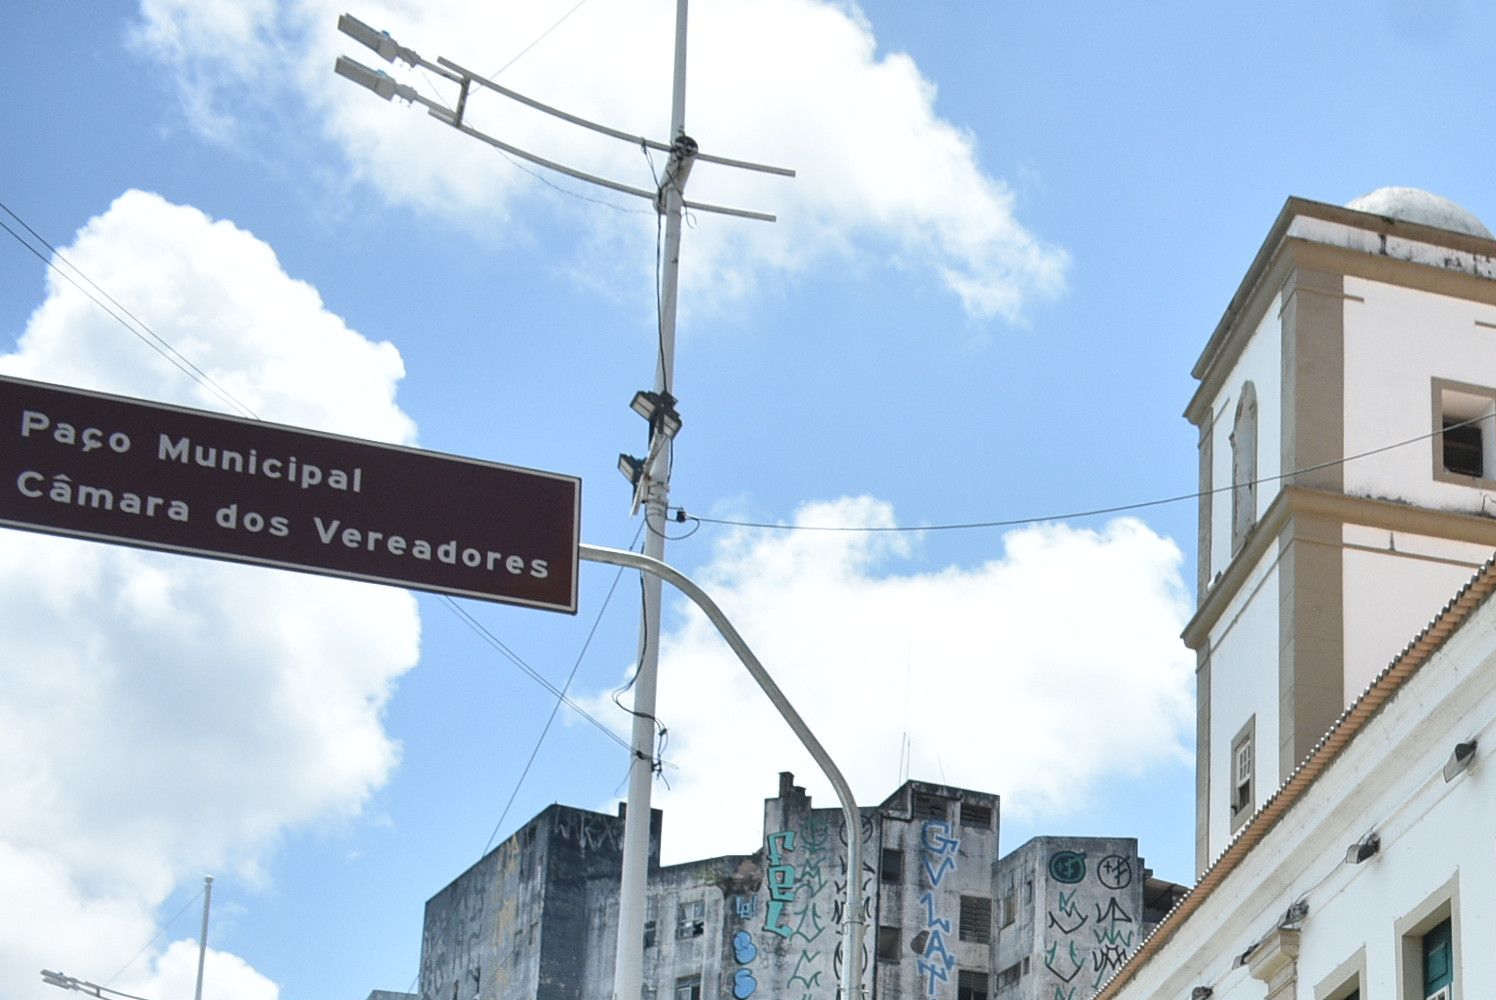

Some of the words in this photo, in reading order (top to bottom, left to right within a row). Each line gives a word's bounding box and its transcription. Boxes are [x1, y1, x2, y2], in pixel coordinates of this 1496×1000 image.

[21, 410, 132, 453] Paço
[159, 434, 363, 493] Municipal
[17, 471, 190, 522] Câmara
[216, 504, 290, 537] dos
[314, 517, 549, 579] Vereadores
